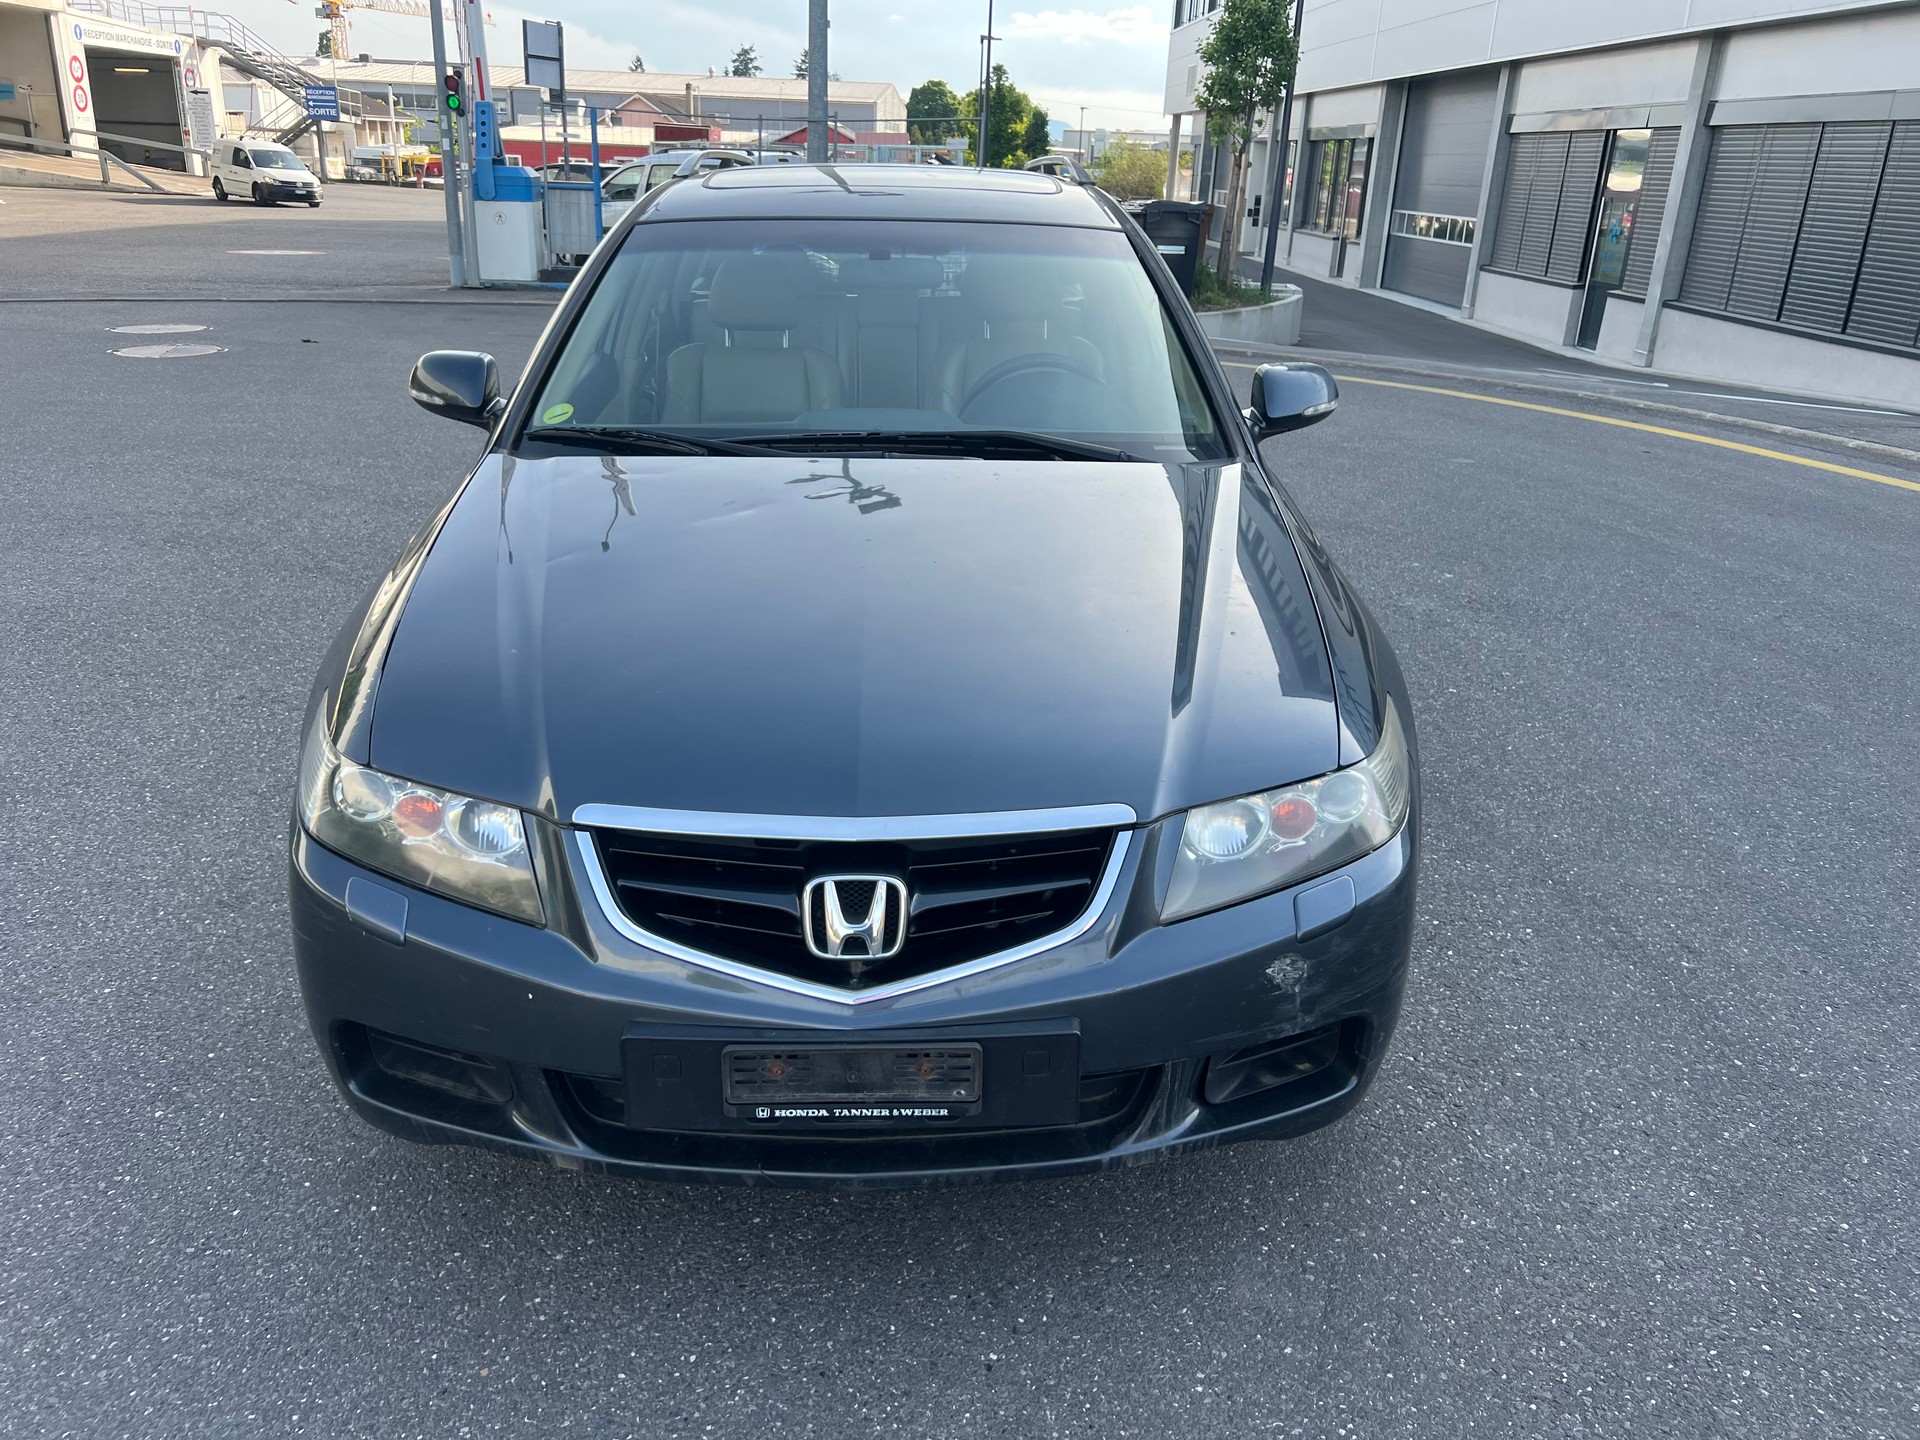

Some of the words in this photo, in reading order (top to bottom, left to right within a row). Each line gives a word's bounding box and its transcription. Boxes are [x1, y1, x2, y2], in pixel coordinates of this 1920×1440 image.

[115, 33, 153, 47] MARCHANDISE
[156, 39, 174, 50] SORTIE
[308, 107, 338, 117] SORTIE
[774, 1109, 830, 1117] HONDA
[833, 1108, 890, 1117] TANNER
